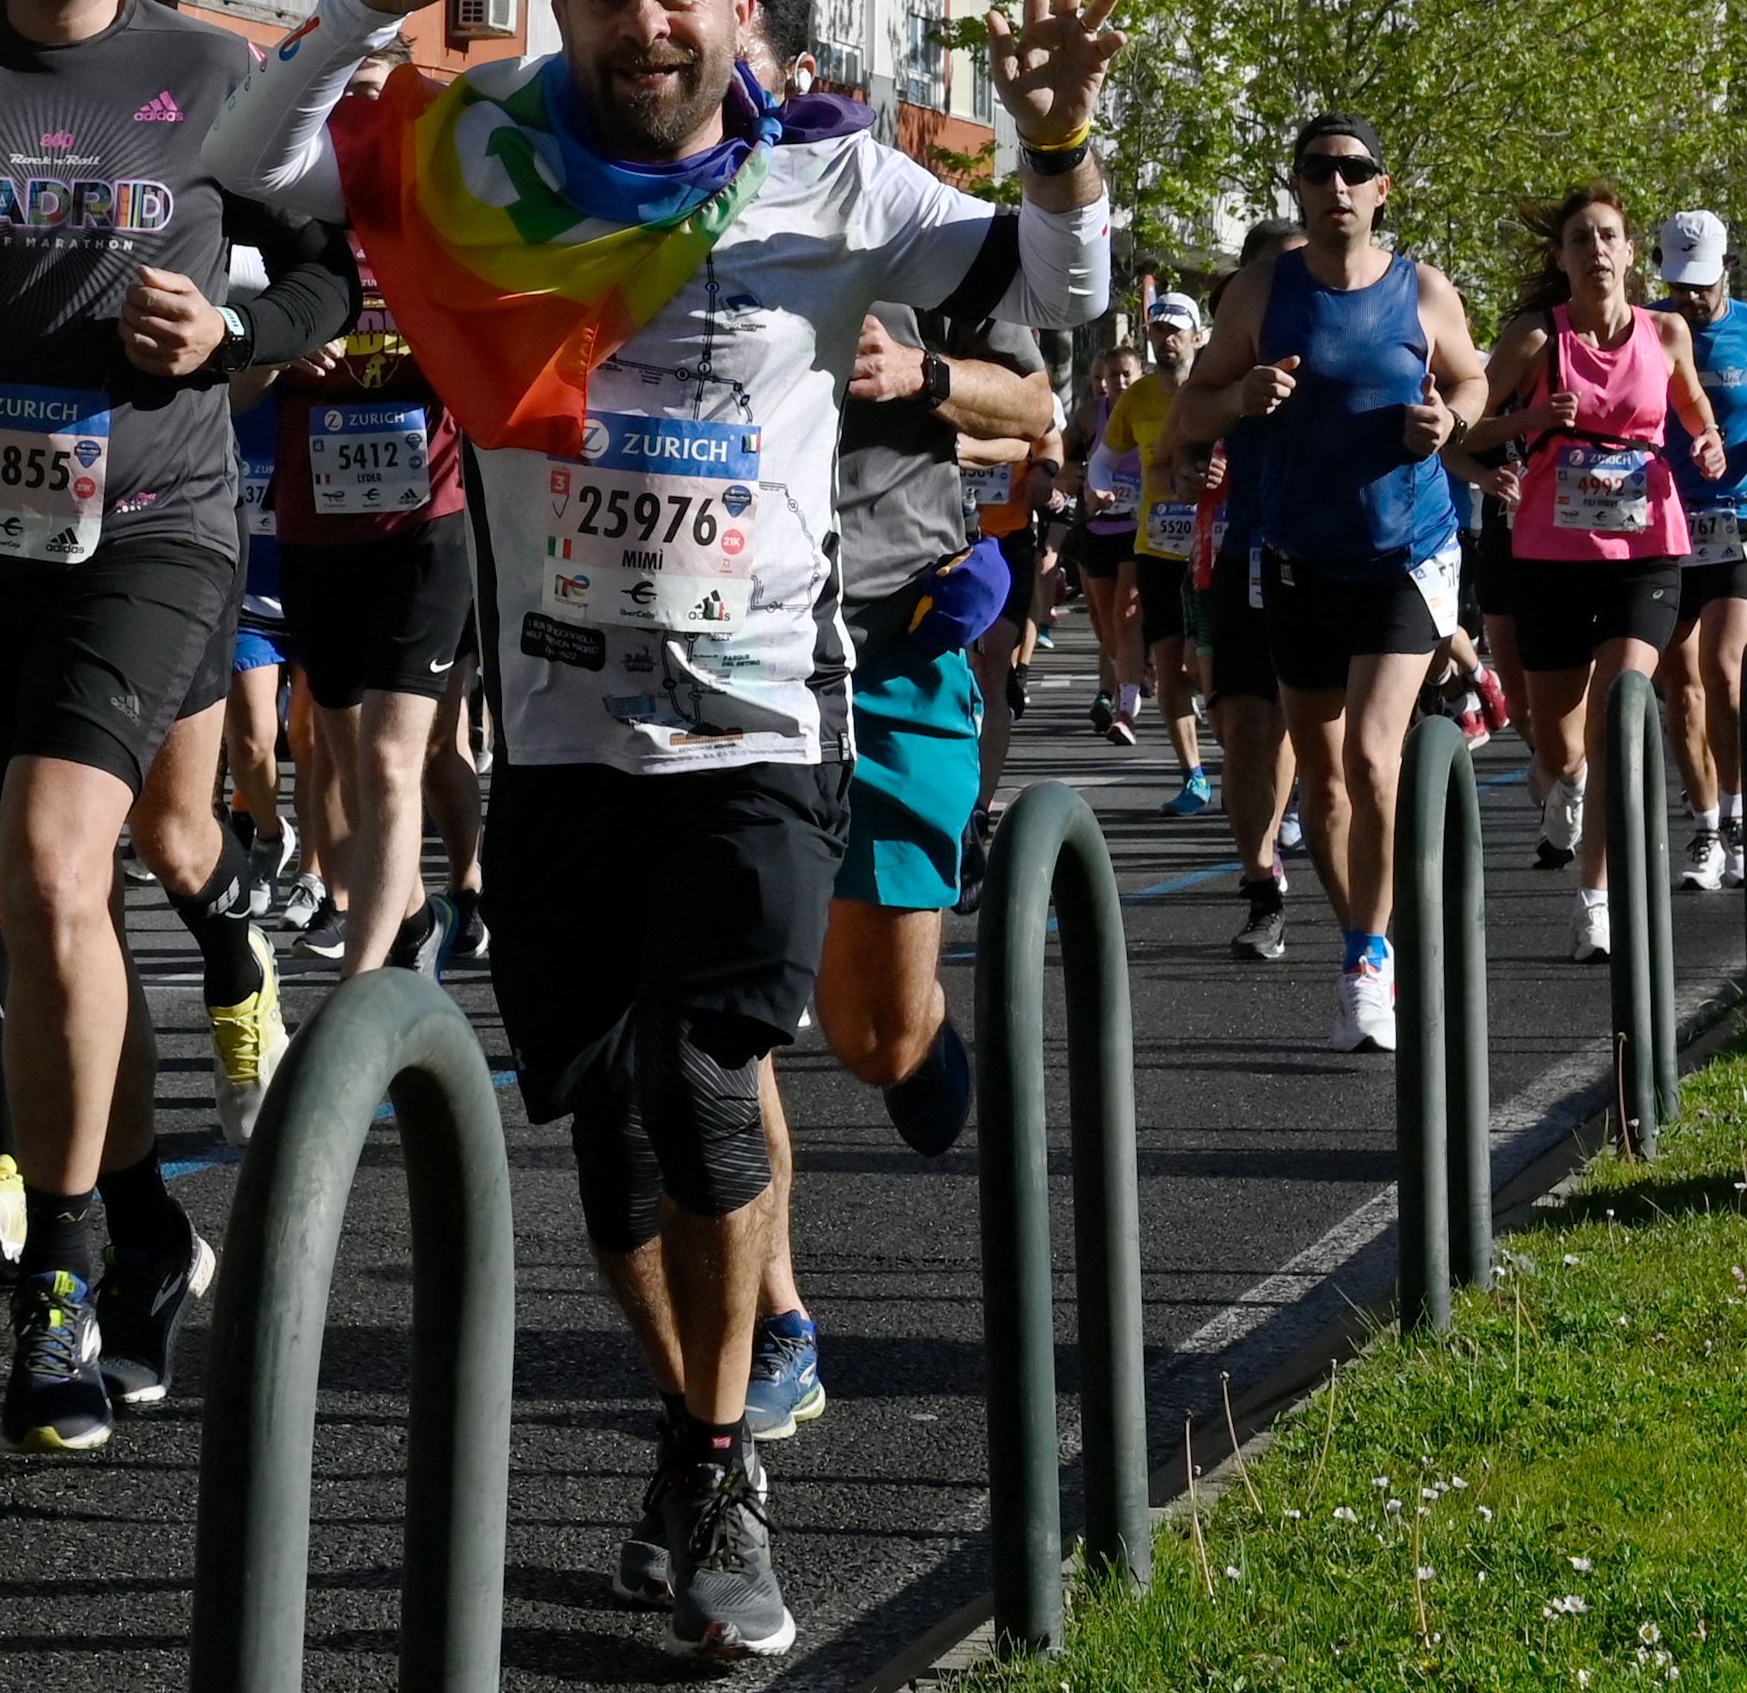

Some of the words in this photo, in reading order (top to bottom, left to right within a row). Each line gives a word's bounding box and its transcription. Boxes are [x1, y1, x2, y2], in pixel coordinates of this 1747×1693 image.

[133, 109, 185, 123] adidas
[9, 152, 52, 166] Rock
[63, 153, 101, 166] Roll
[25, 236, 135, 251] MARATHON
[348, 411, 406, 427] ZURICH
[338, 441, 399, 470] 5412
[621, 432, 728, 463] ZURICH
[554, 475, 564, 492] 3
[1578, 476, 1625, 497] 4992
[577, 485, 718, 547] 25976
[1159, 519, 1192, 535] 5520
[45, 543, 85, 554] adidas
